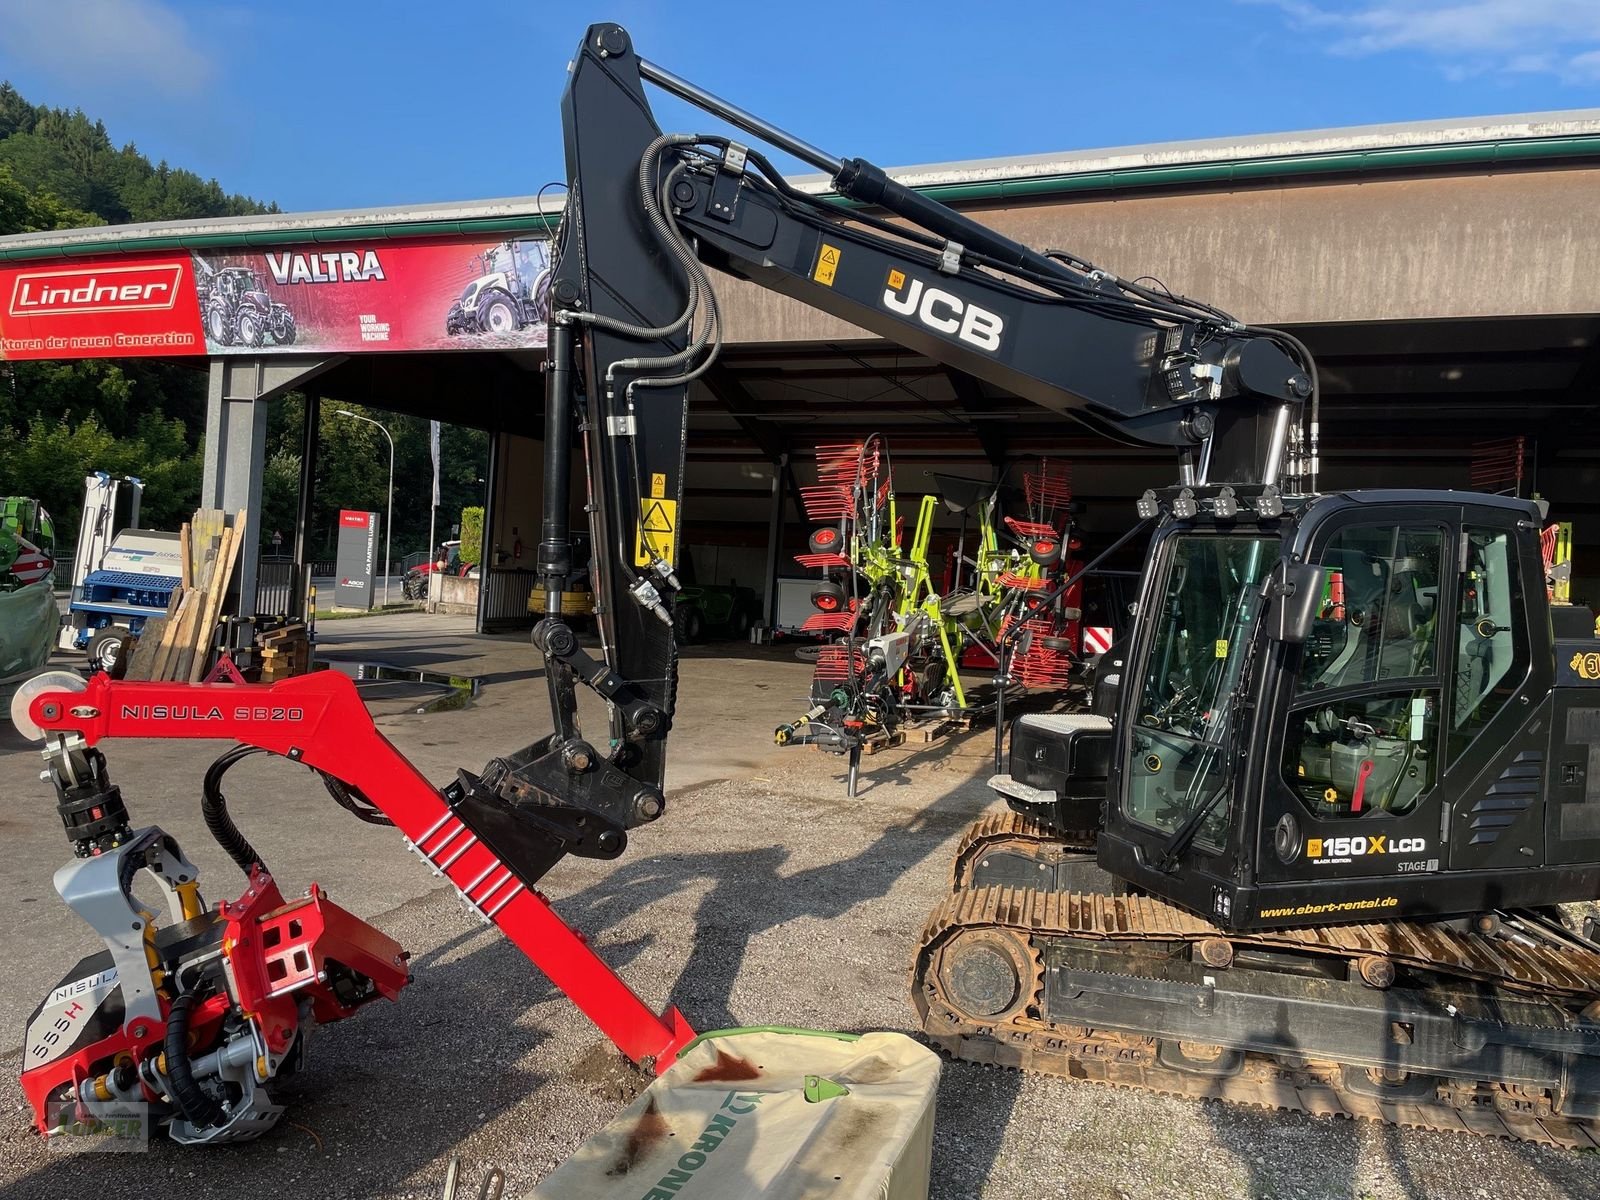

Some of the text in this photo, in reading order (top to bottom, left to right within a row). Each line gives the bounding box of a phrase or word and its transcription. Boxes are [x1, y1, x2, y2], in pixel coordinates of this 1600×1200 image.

[264, 250, 387, 285] VALTRA
[20, 279, 167, 306] Lindner
[359, 314, 376, 323] YOUR
[884, 279, 1003, 351] JCB
[360, 323, 390, 332] WORKING
[47, 336, 68, 349] der
[71, 336, 112, 348] neuen
[114, 332, 195, 347] Generation
[361, 332, 389, 341] MACHINE
[121, 704, 304, 720] NISULA SB20
[1397, 861, 1426, 872] STAGE
[1260, 897, 1398, 918] www.ebert-rental.de
[32, 1002, 83, 1059] 555H
